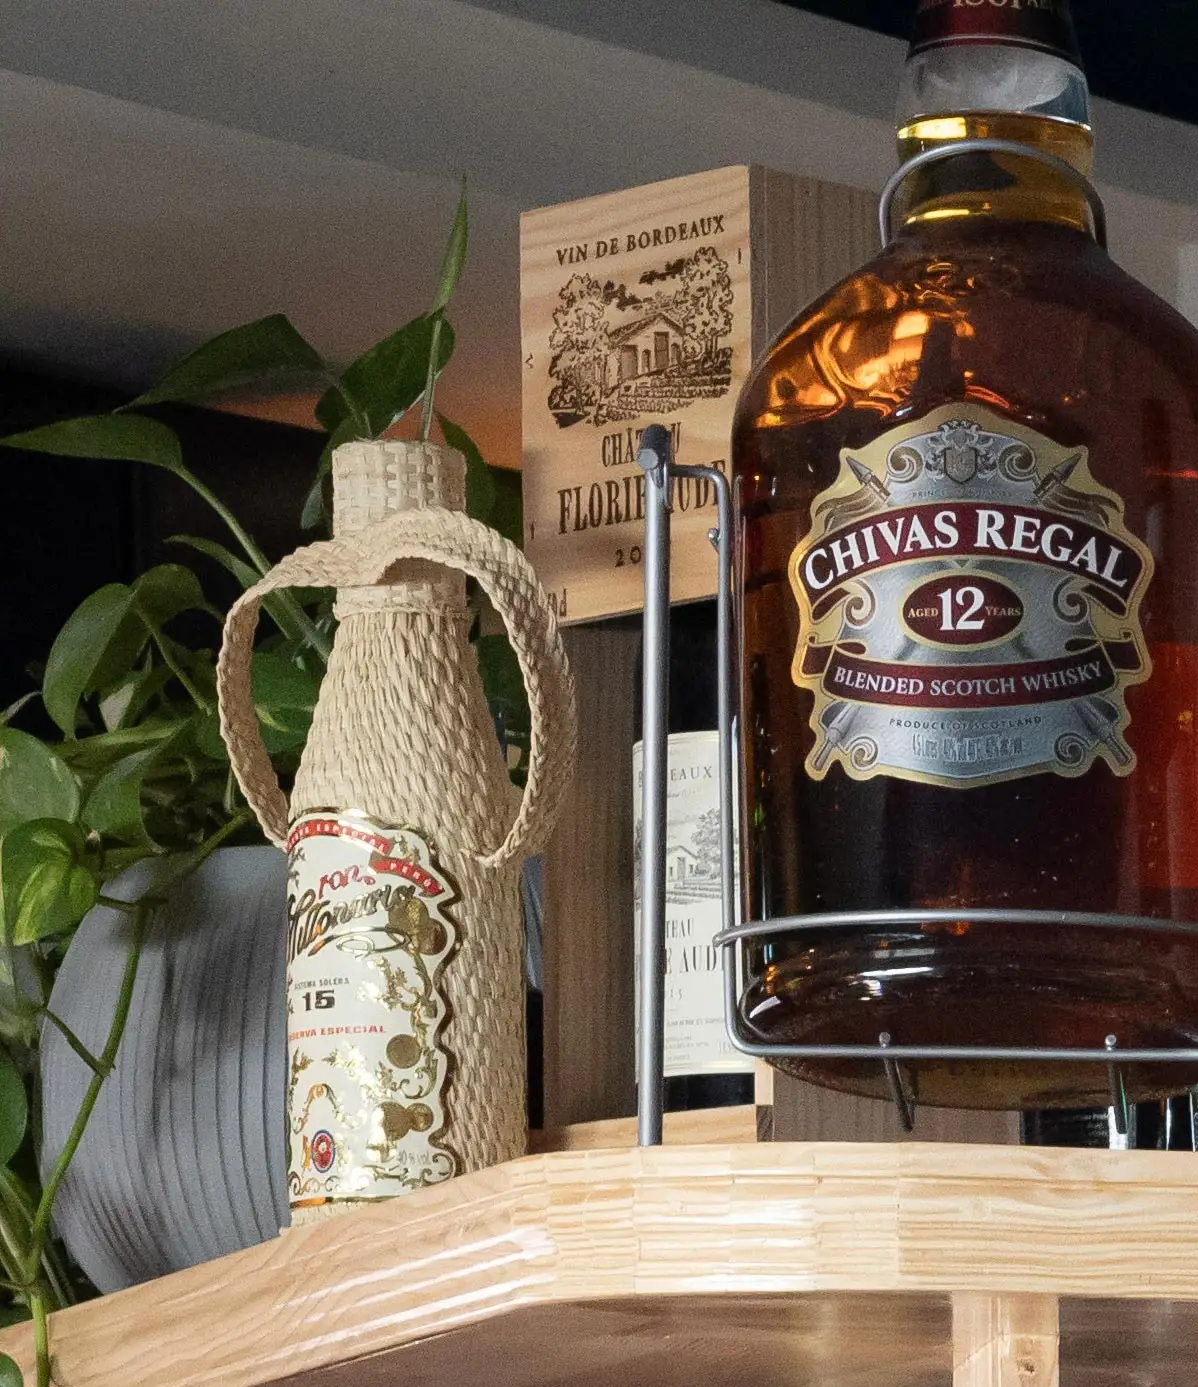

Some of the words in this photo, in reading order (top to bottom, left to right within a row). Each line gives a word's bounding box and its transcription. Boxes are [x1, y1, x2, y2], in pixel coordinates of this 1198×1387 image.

[556, 244, 588, 266] VIN
[595, 237, 619, 259] DE
[626, 215, 725, 252] BORDEAUX
[602, 422, 682, 467] CHÂTU
[668, 460, 726, 515] UDE
[804, 510, 959, 590] CHIVAS
[975, 509, 1127, 588] REGAL
[907, 606, 939, 619] AGED
[937, 586, 985, 632] 12
[985, 605, 1021, 618] YEARS
[834, 665, 924, 696] BLENDED
[930, 678, 1015, 697] SCOTCH
[1023, 660, 1102, 691] WHISKY
[889, 718, 946, 731] PRODUCE
[952, 721, 968, 731] OF
[974, 715, 1042, 730] SCOTLAND
[680, 944, 724, 973] AUD
[302, 989, 336, 1012] 15
[319, 977, 350, 987] SOLERA
[288, 1029, 317, 1041] SERVA
[320, 1024, 386, 1037] ESPECIAL
